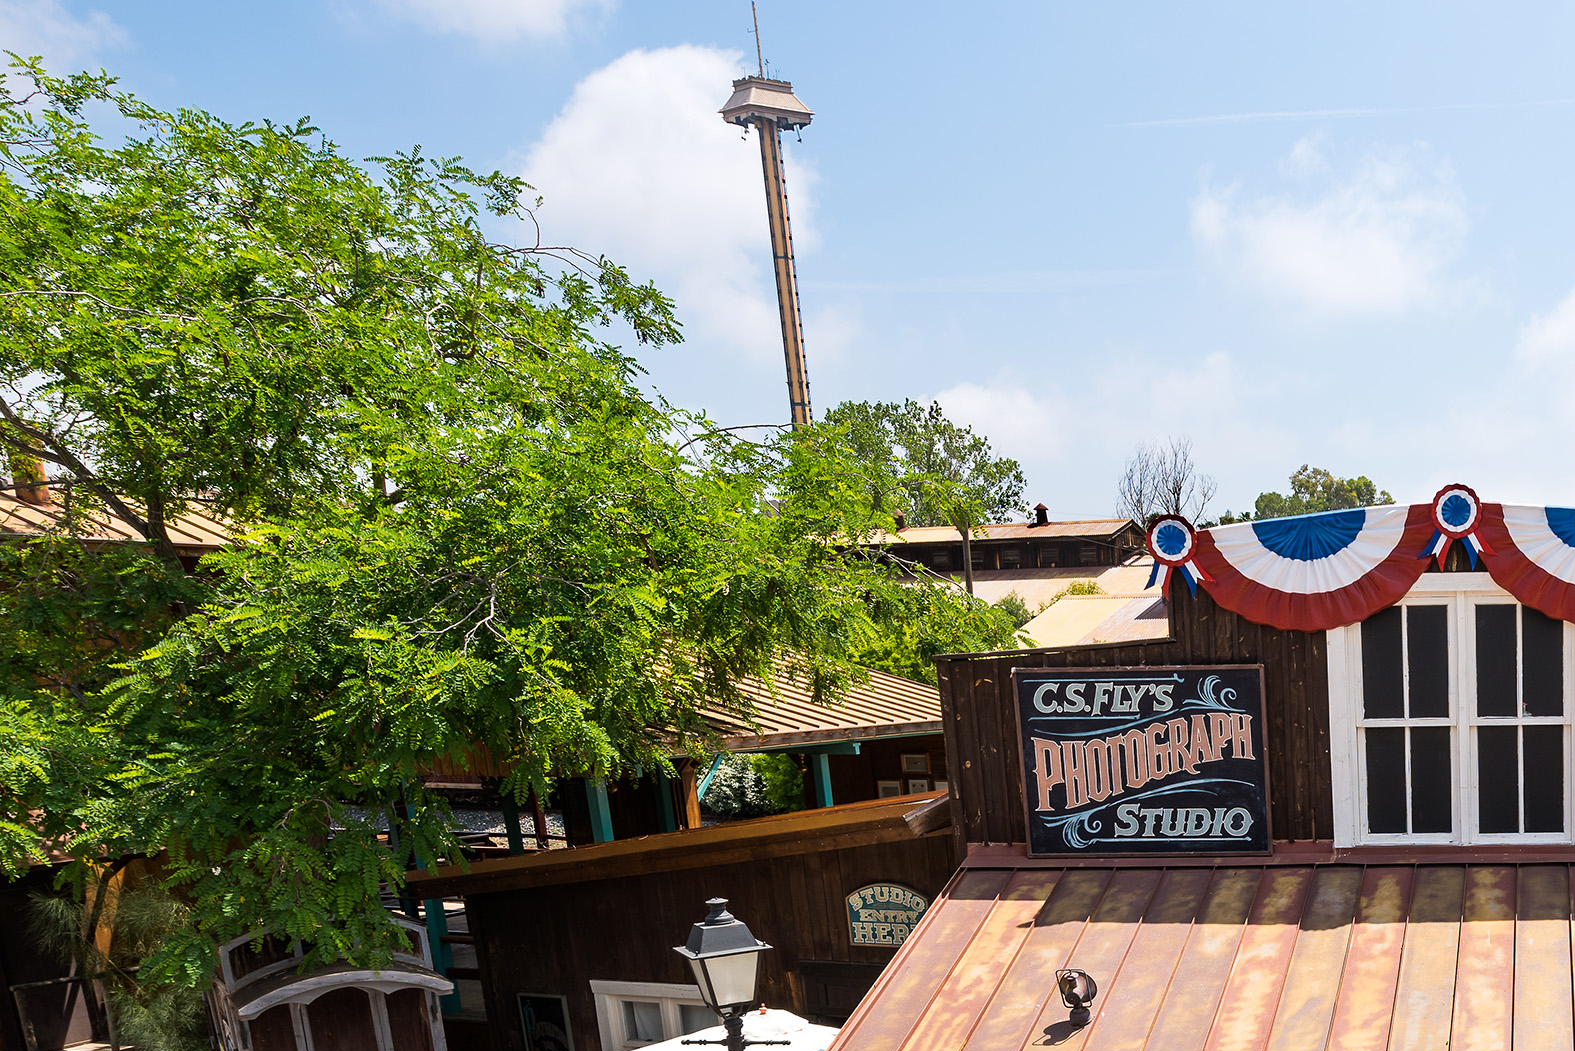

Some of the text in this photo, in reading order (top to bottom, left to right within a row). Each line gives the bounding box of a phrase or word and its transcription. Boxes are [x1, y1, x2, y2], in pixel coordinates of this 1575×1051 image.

[1031, 712, 1256, 812] PHOTOGRAPH
[1114, 803, 1255, 838] STUDIO
[848, 886, 925, 912] STUDIO
[859, 909, 919, 923] ENTRY
[852, 921, 916, 944] HER
